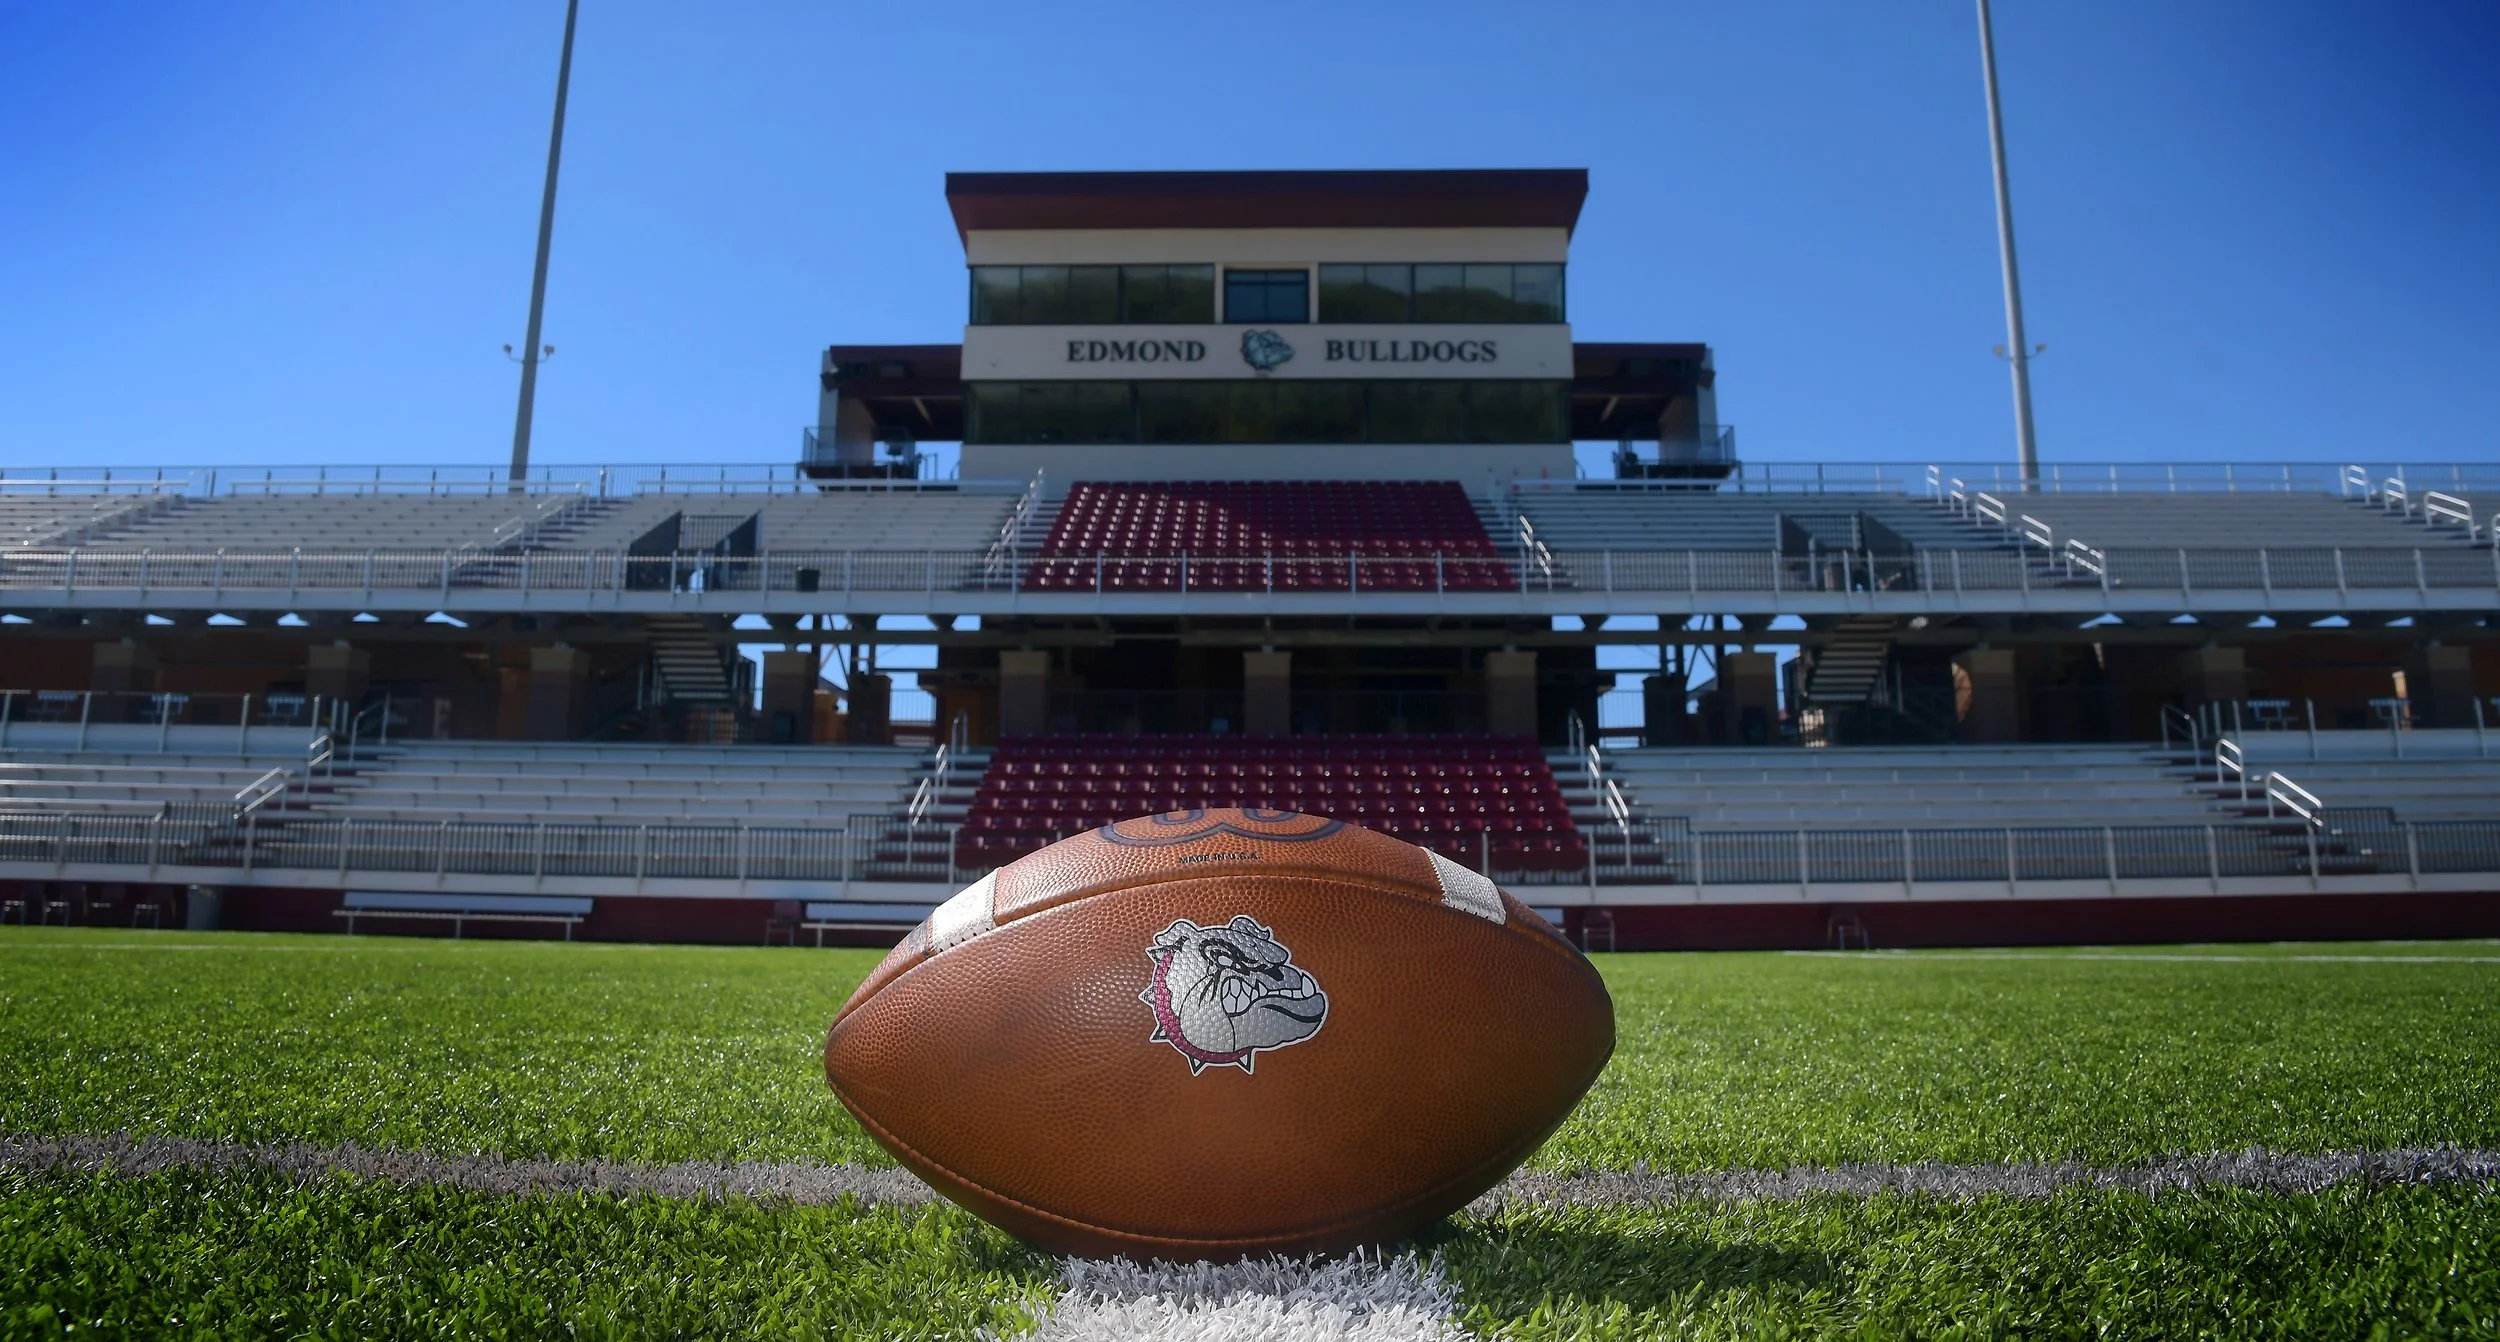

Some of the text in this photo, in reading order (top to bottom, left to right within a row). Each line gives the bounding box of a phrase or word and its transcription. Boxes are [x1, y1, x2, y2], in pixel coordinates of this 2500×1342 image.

[1067, 339, 1498, 363] EDMOND BULLDOGS
[1178, 854, 1211, 865] MADE
[1213, 852, 1226, 862] IN
